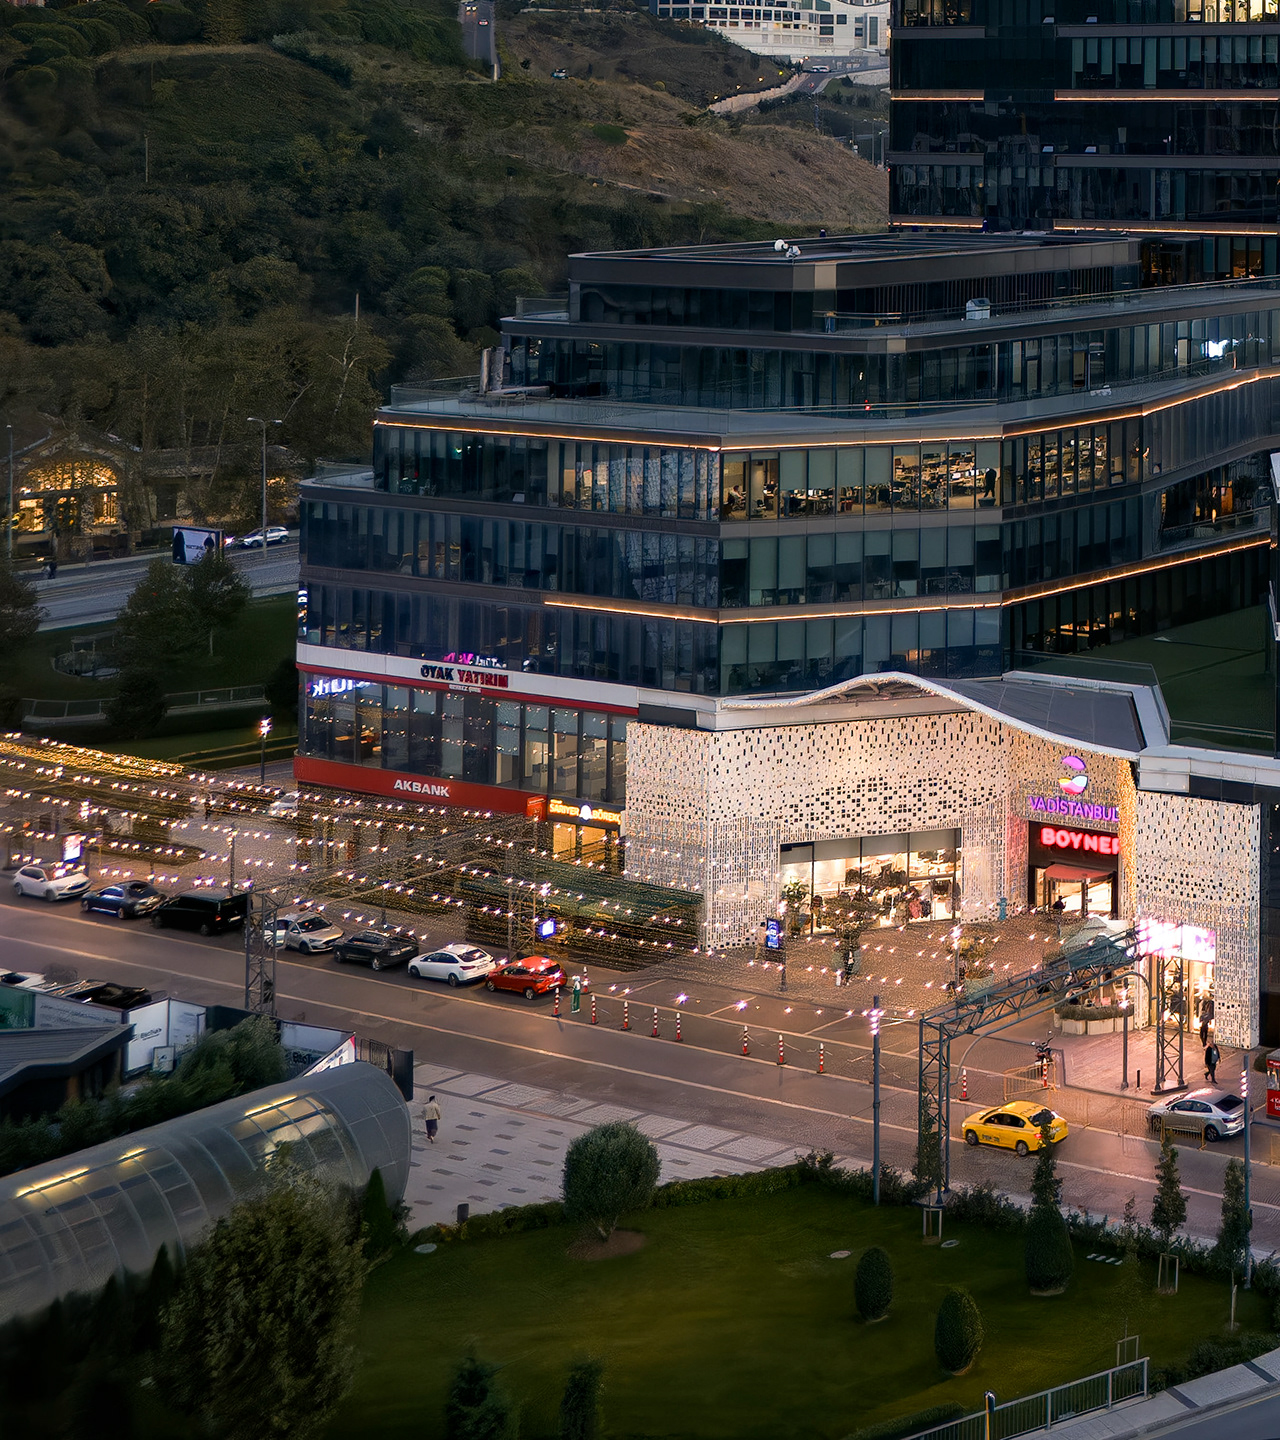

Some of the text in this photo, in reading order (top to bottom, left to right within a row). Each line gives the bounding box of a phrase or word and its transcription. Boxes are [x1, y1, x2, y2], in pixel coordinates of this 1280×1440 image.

[420, 665, 508, 688] OYAK YATIRIM
[393, 779, 450, 797] AKBANK
